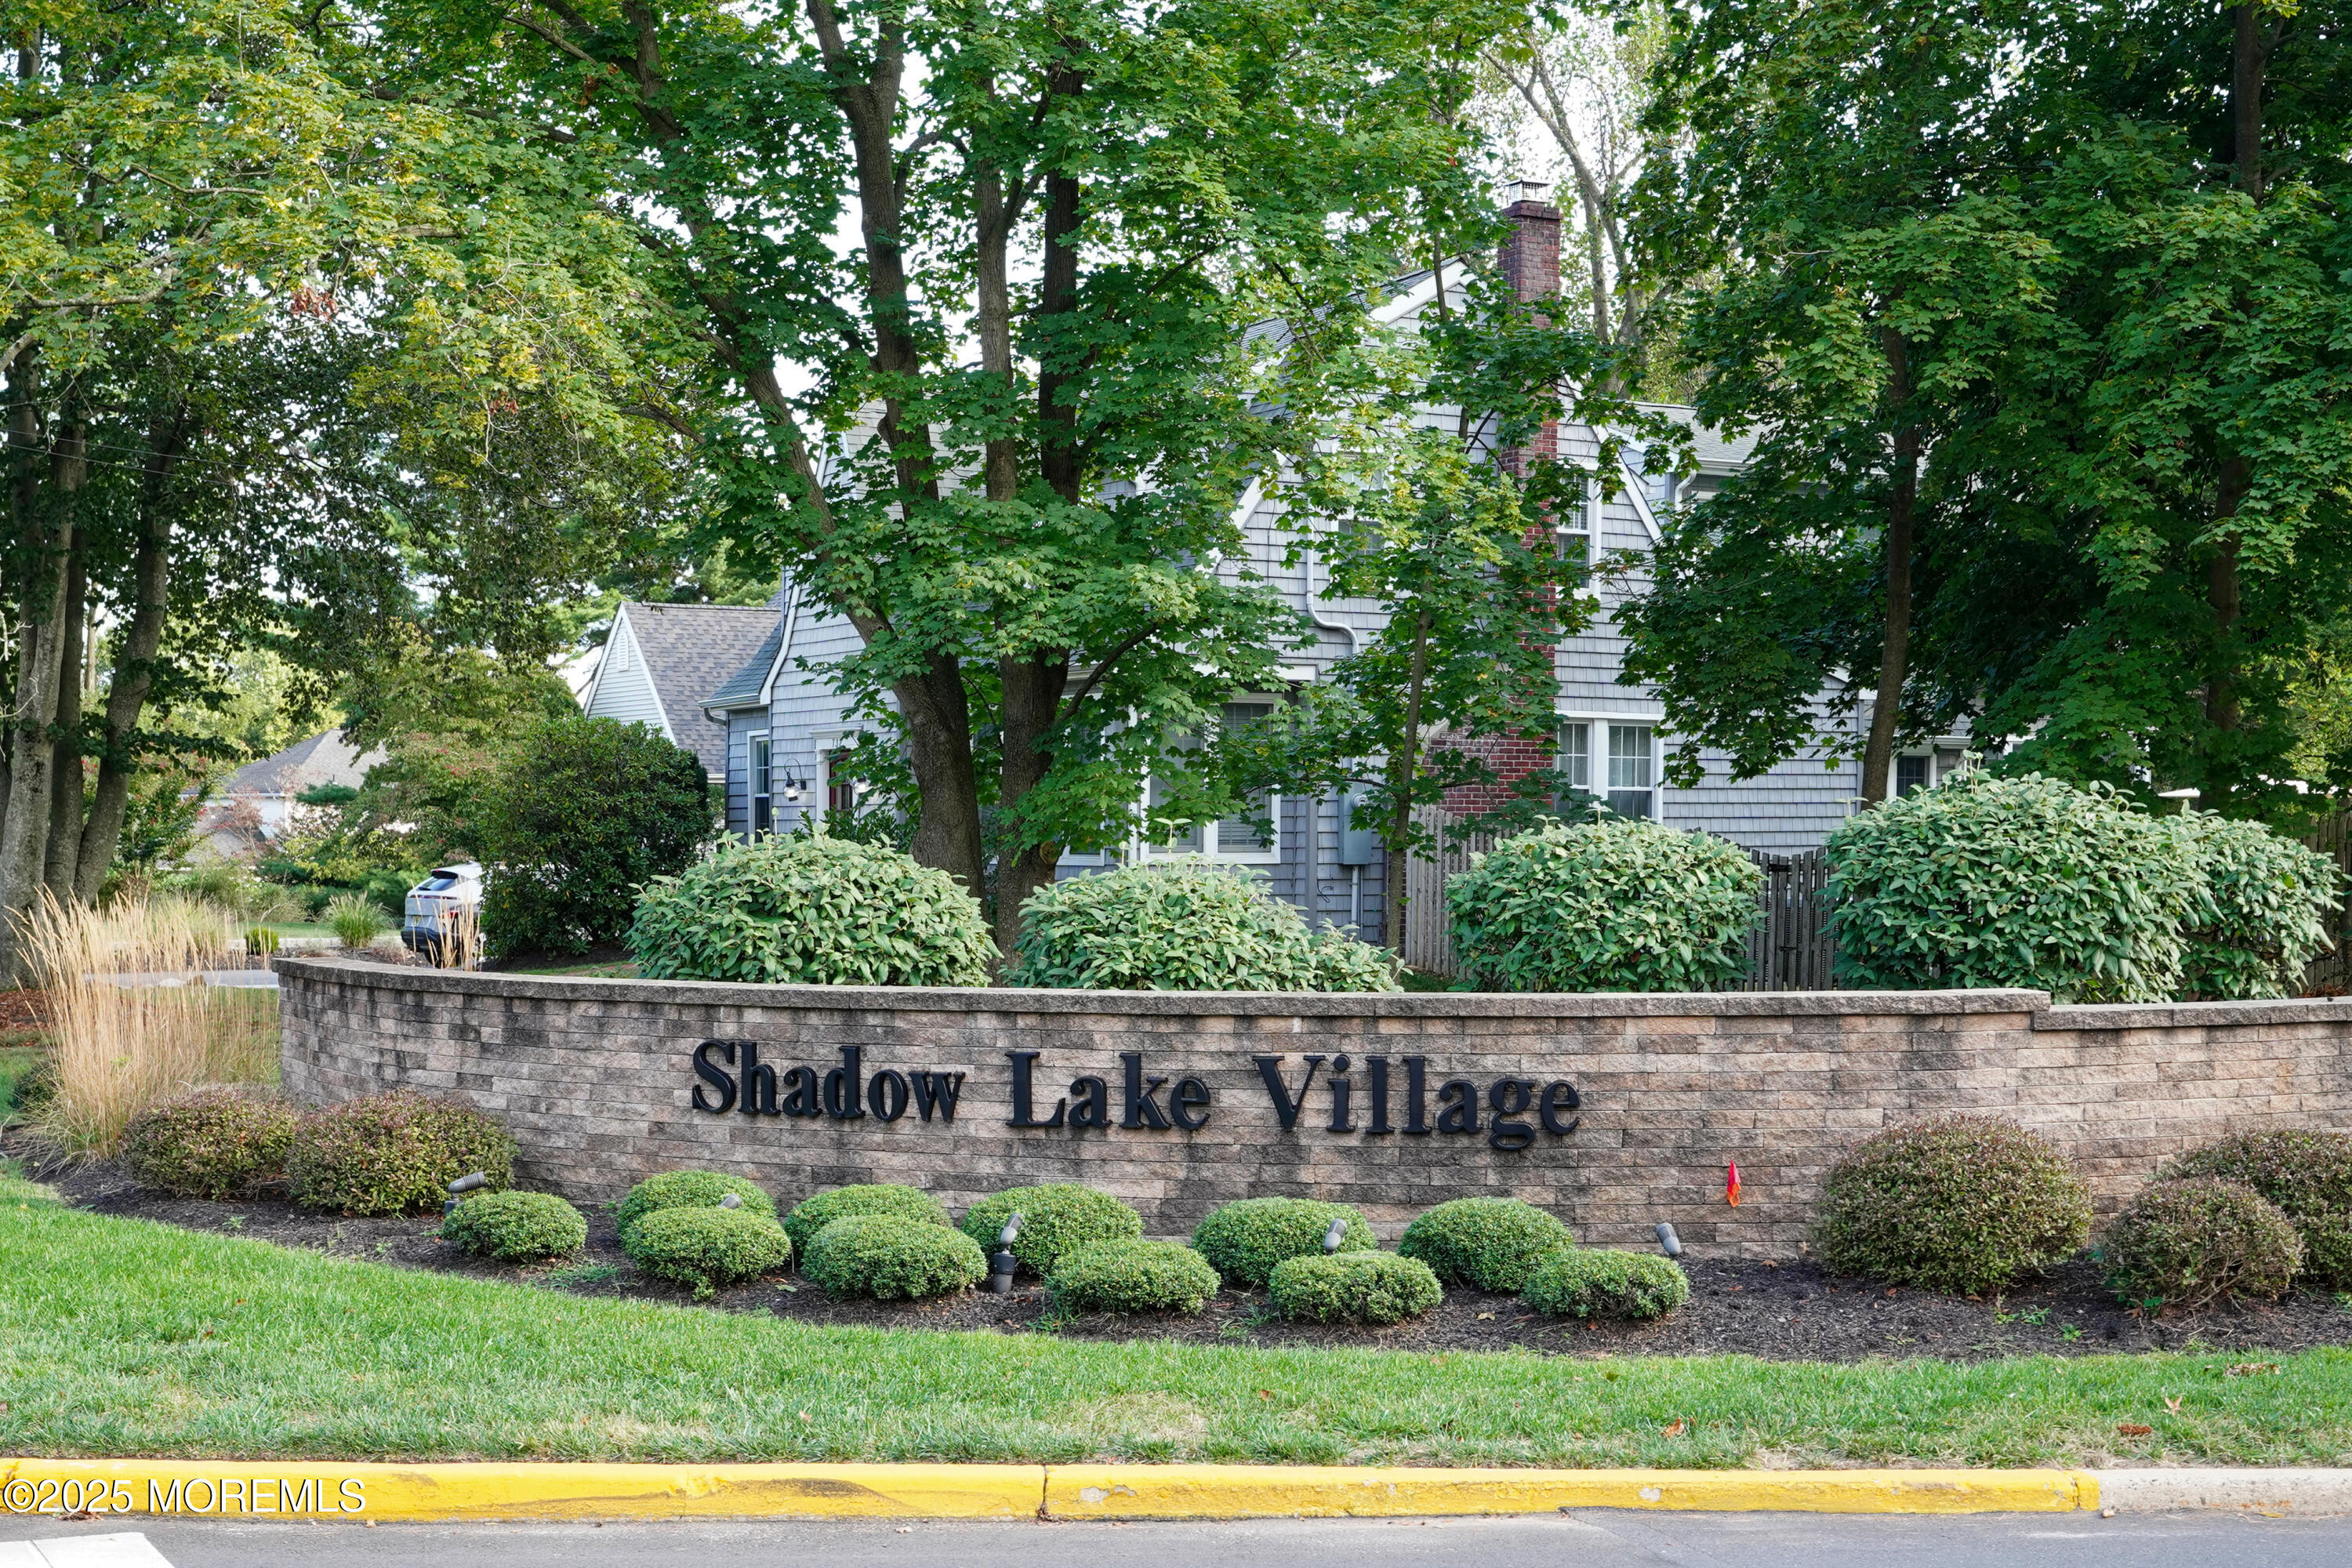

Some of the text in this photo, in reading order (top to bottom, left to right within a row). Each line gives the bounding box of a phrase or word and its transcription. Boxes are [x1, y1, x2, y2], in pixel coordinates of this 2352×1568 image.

[691, 1040, 1581, 1150] Shadow Lake Village
